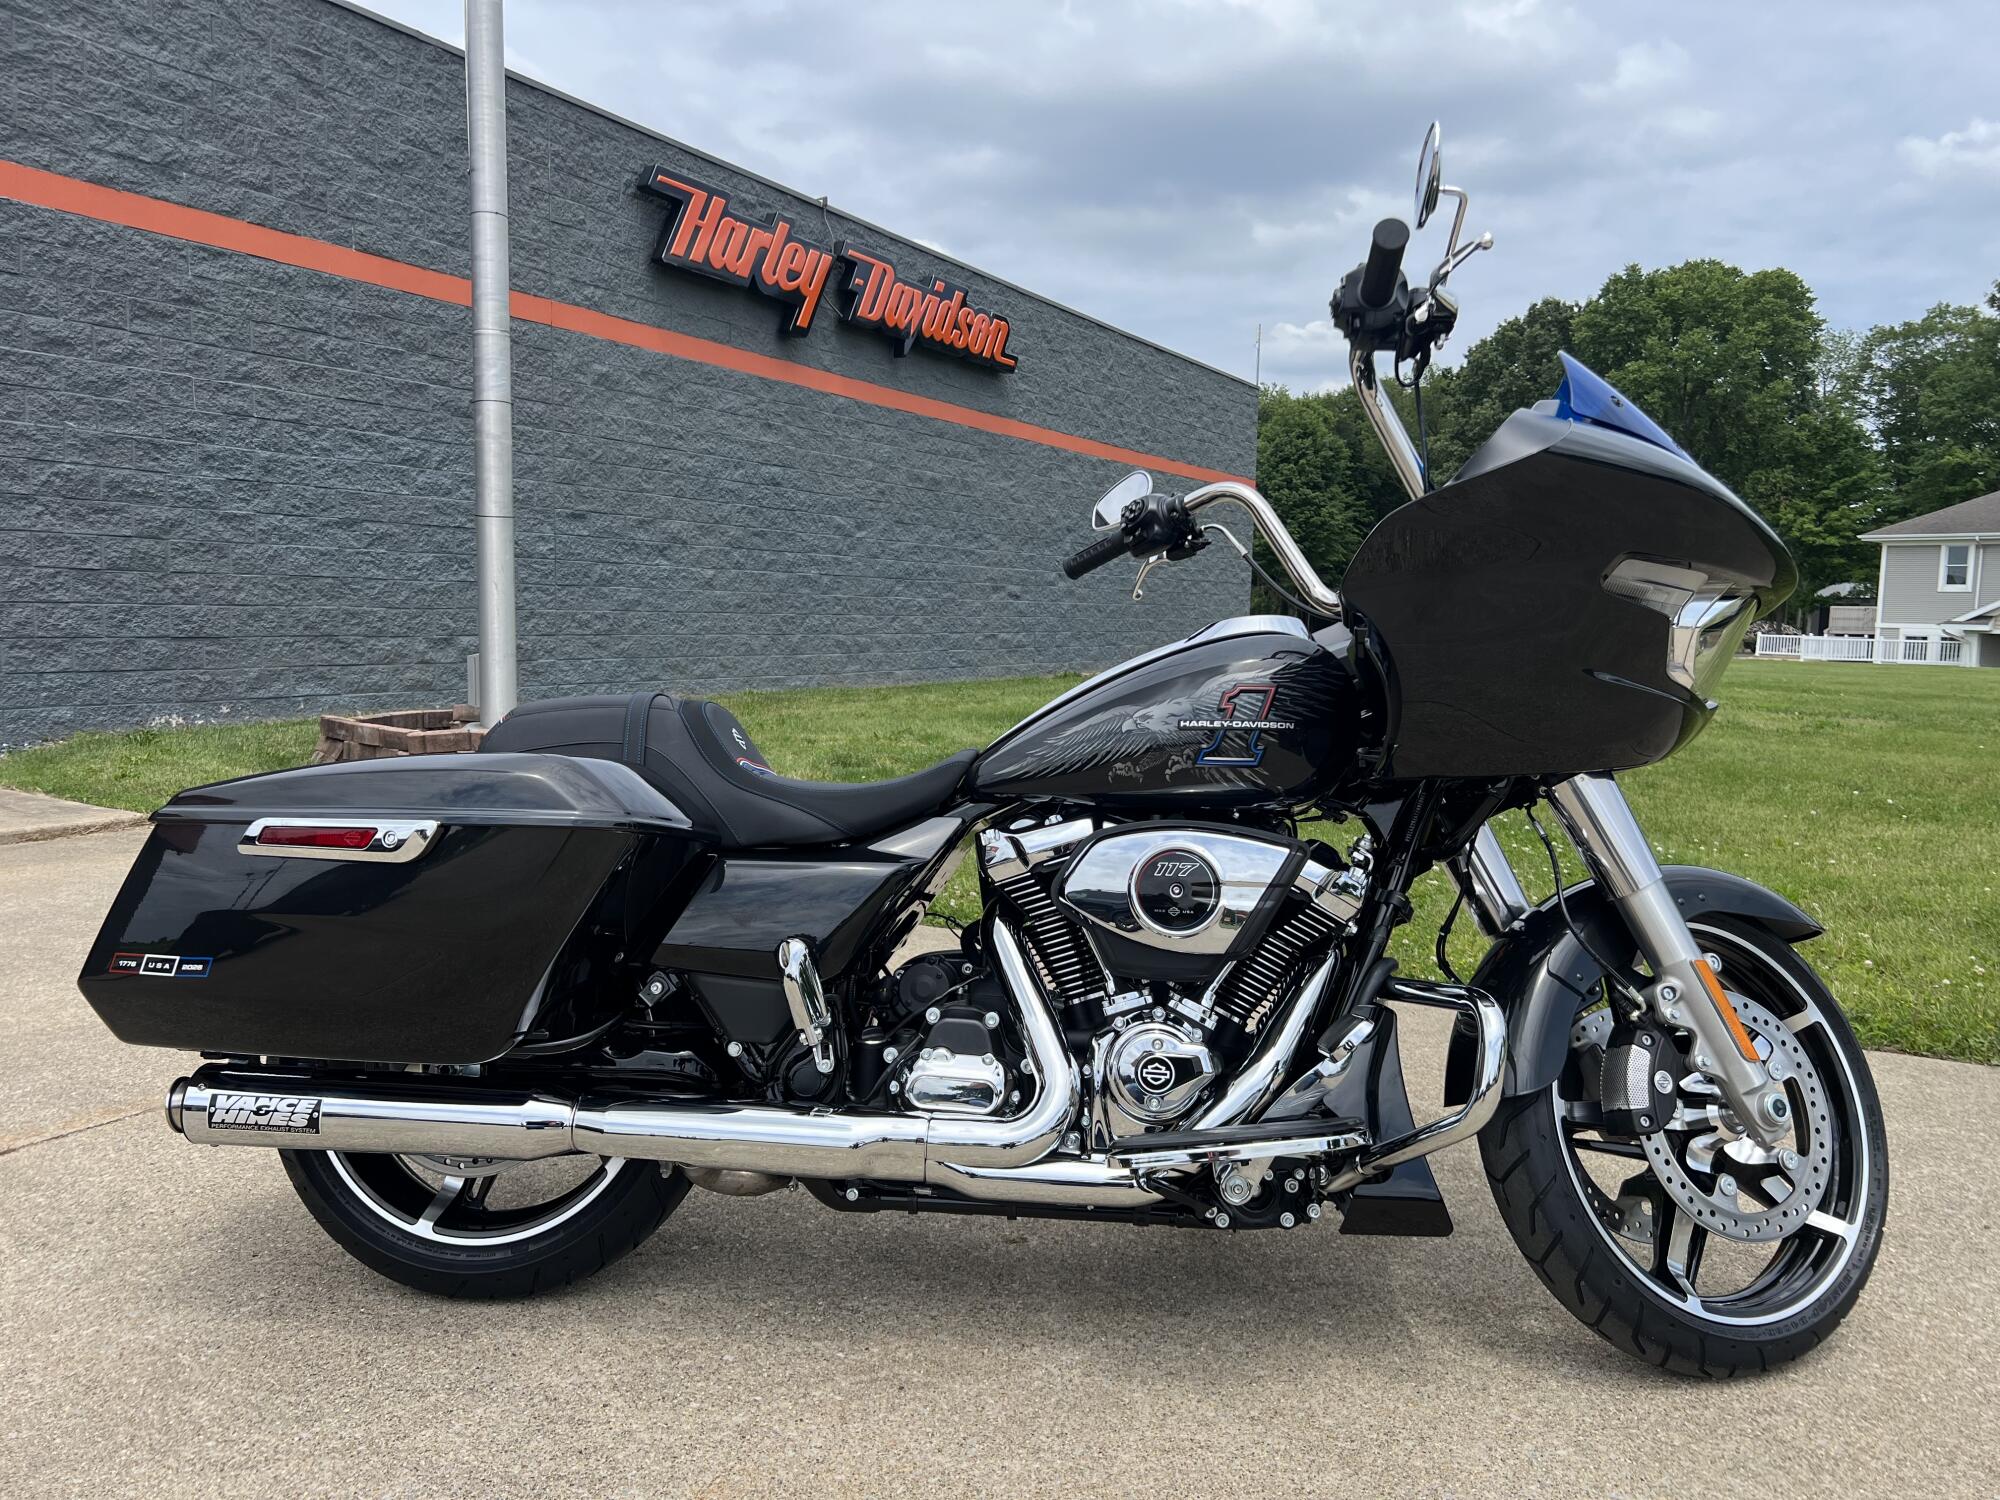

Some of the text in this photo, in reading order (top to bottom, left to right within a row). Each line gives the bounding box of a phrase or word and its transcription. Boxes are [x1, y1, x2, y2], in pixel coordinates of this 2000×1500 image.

[1180, 720, 1295, 729] HARLEY-DAVIDSON
[1154, 862, 1200, 877] 117
[215, 1094, 318, 1114] VANCE
[211, 1109, 311, 1128] HINES
[211, 1123, 259, 1131] PERFORMANCE
